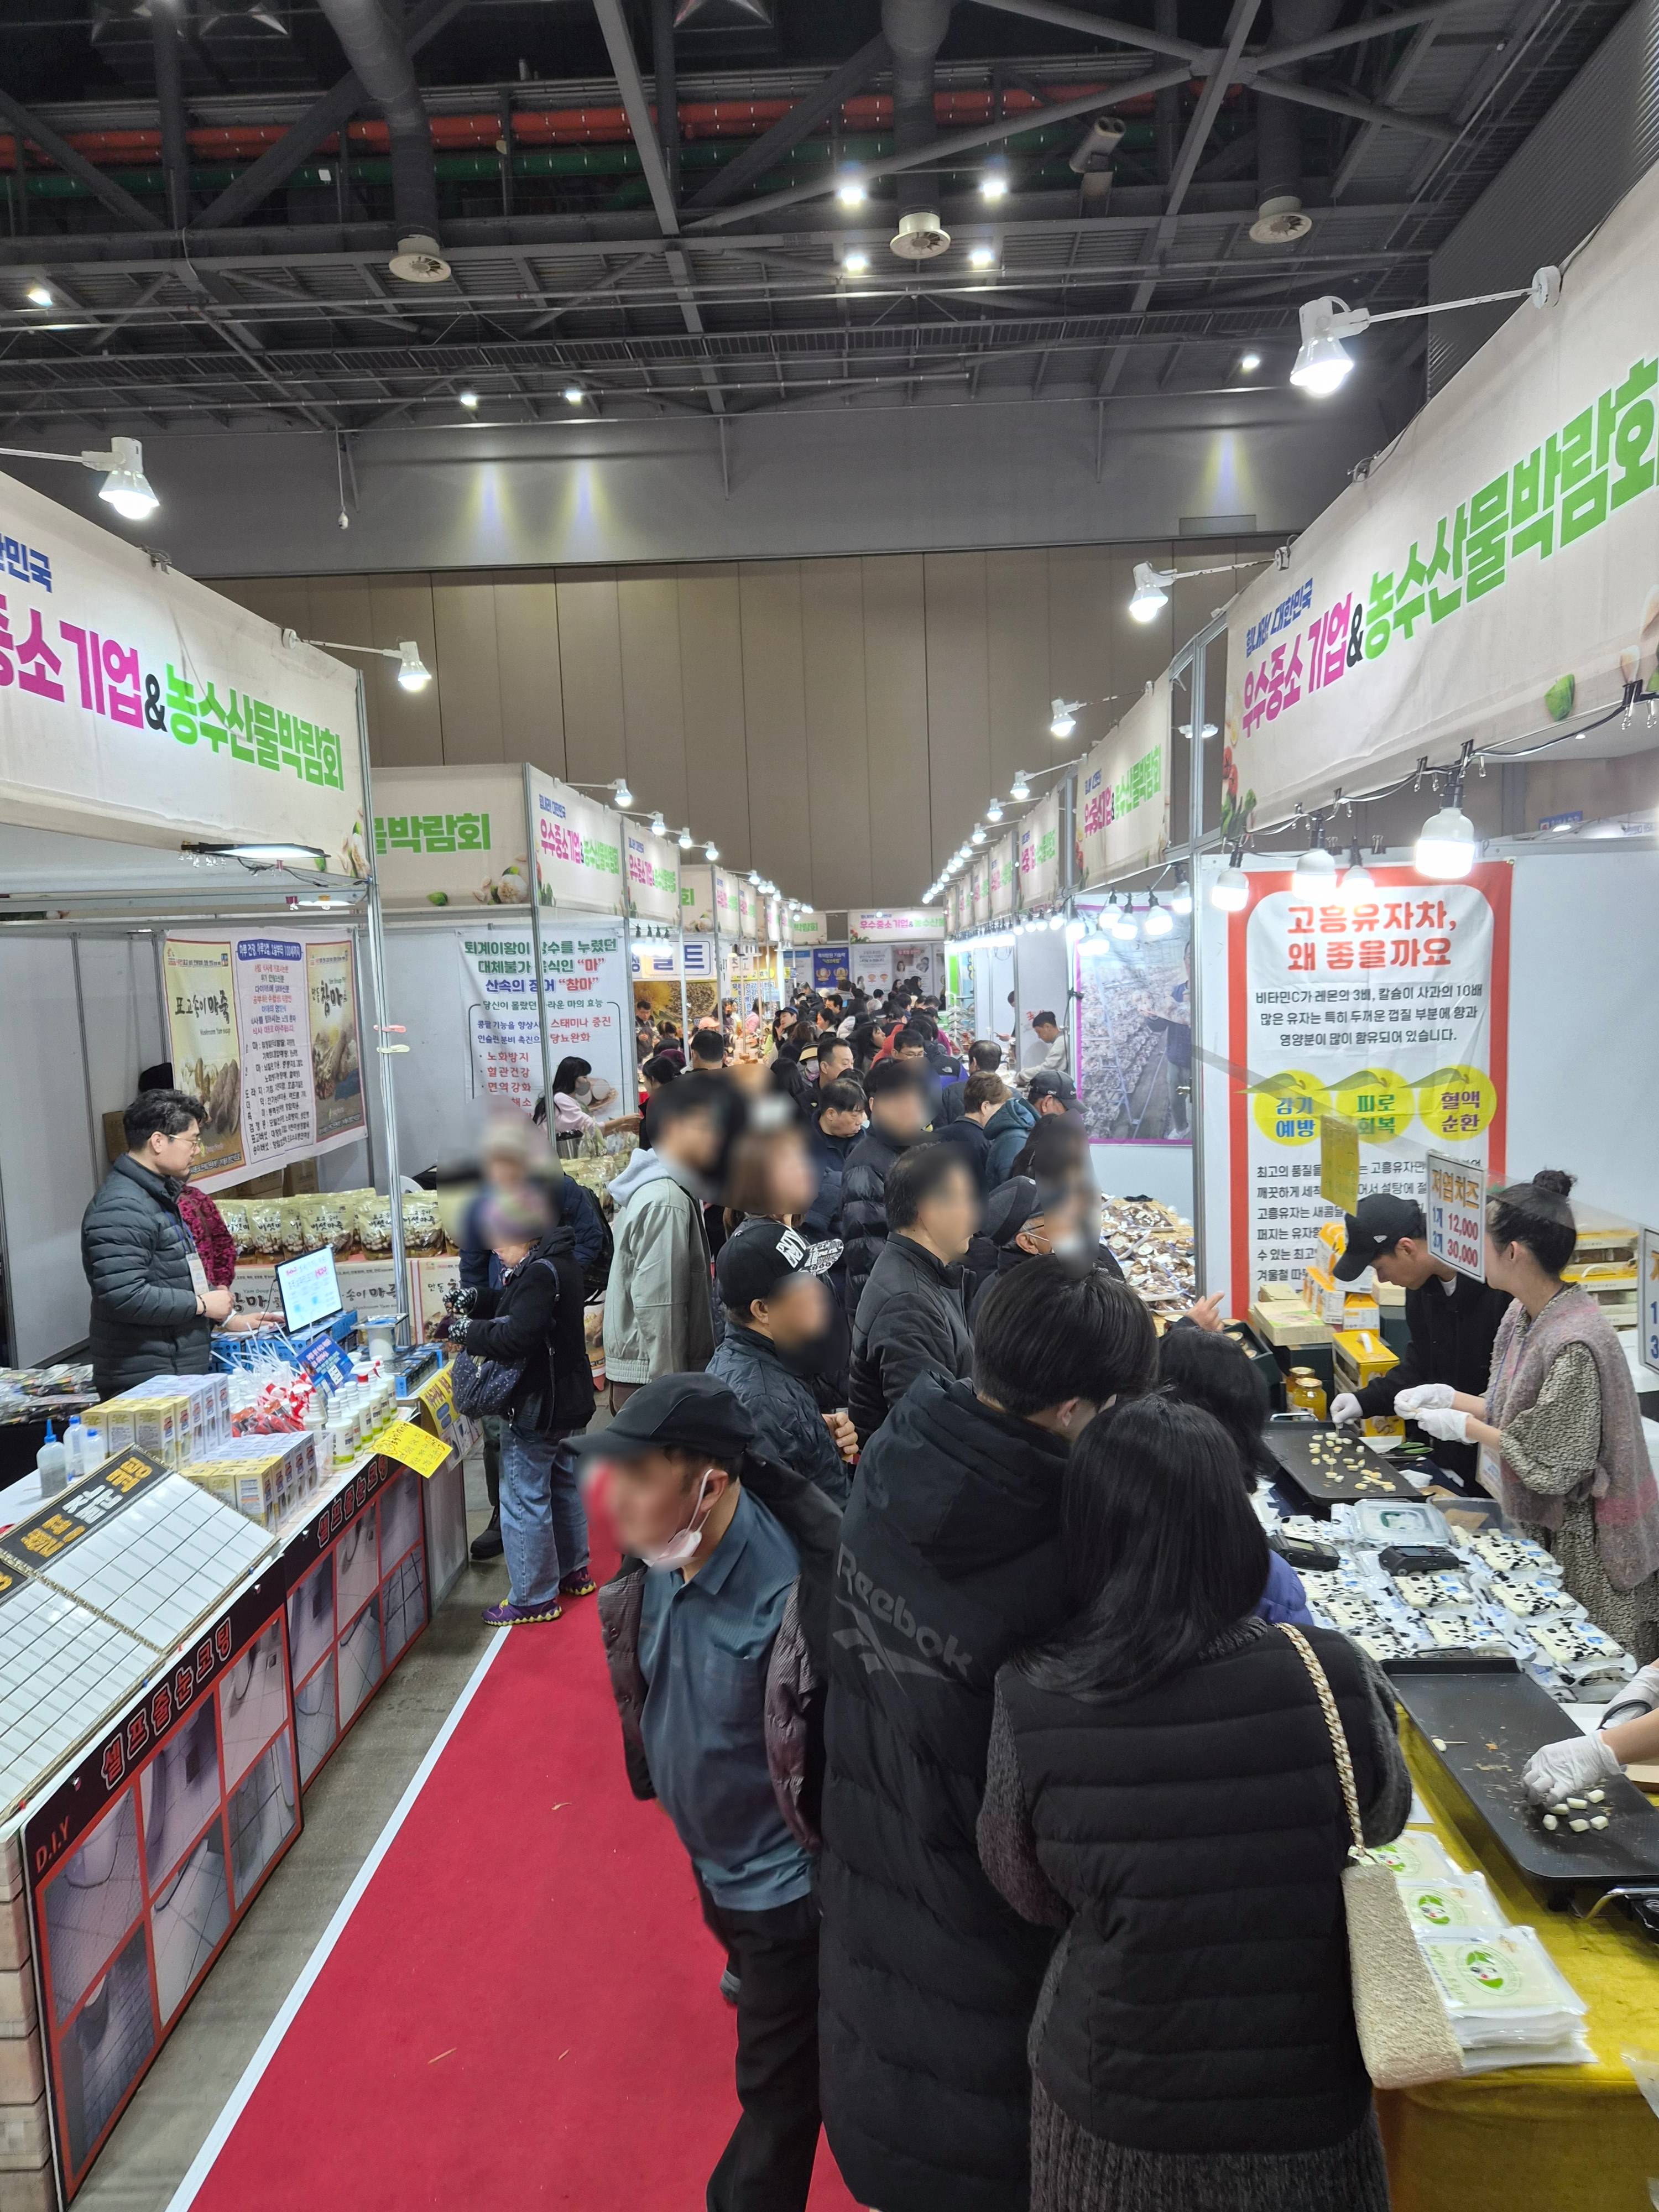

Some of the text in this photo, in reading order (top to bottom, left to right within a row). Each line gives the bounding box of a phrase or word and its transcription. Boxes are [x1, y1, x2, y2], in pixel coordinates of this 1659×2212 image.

[0, 533, 53, 593] 민국
[1270, 578, 1313, 635] 대한민국
[1287, 900, 1457, 935] 고흥유자차,
[465, 941, 530, 955] 퇴계이황이
[577, 938, 616, 953] 누렸던
[1288, 937, 1452, 971] 왜 좋을까요
[478, 960, 530, 974] 대체불가
[485, 979, 524, 992] 산속의
[1256, 983, 1483, 1004] 비타민C가 레몬의 3배, 칼슘이 사과의 10배
[482, 999, 603, 1010] 당신이 몰랐던 라운 마의 효능
[550, 1018, 588, 1029] 스태미나
[592, 1016, 611, 1027] 증진
[1261, 1006, 1478, 1027] 많은 유자는 특히 두꺼운 껍질 부분에 향과
[550, 1032, 590, 1044] 당뇨완화
[1280, 1029, 1457, 1047] 영양분이 많이 함유되어 있습니다.
[487, 1052, 529, 1062] 노화방지
[487, 1067, 530, 1078] 혈관건강
[487, 1083, 531, 1093] 면역강화
[1276, 1097, 1314, 1115] 감기
[1357, 1094, 1396, 1113] 피로
[1441, 1091, 1480, 1110] 혈액
[1276, 1119, 1315, 1138] 예방
[1358, 1117, 1396, 1135] 회복
[1441, 1114, 1479, 1133] 순환
[1257, 1166, 1288, 1178] 최고의
[1257, 1186, 1300, 1199] 깨끗하게
[1382, 1181, 1413, 1194] 설탕에
[1432, 1169, 1480, 1210] 저염치즈
[1257, 1207, 1310, 1220] 고흥유자는
[1257, 1228, 1288, 1241] 퍼지는
[1448, 1213, 1479, 1241] 12,000
[1257, 1249, 1267, 1261] 수
[1270, 1248, 1291, 1260] 있는
[1447, 1238, 1478, 1267] 30,000
[1257, 1269, 1288, 1282] 겨울철
[837, 1542, 973, 1678] Reebok
